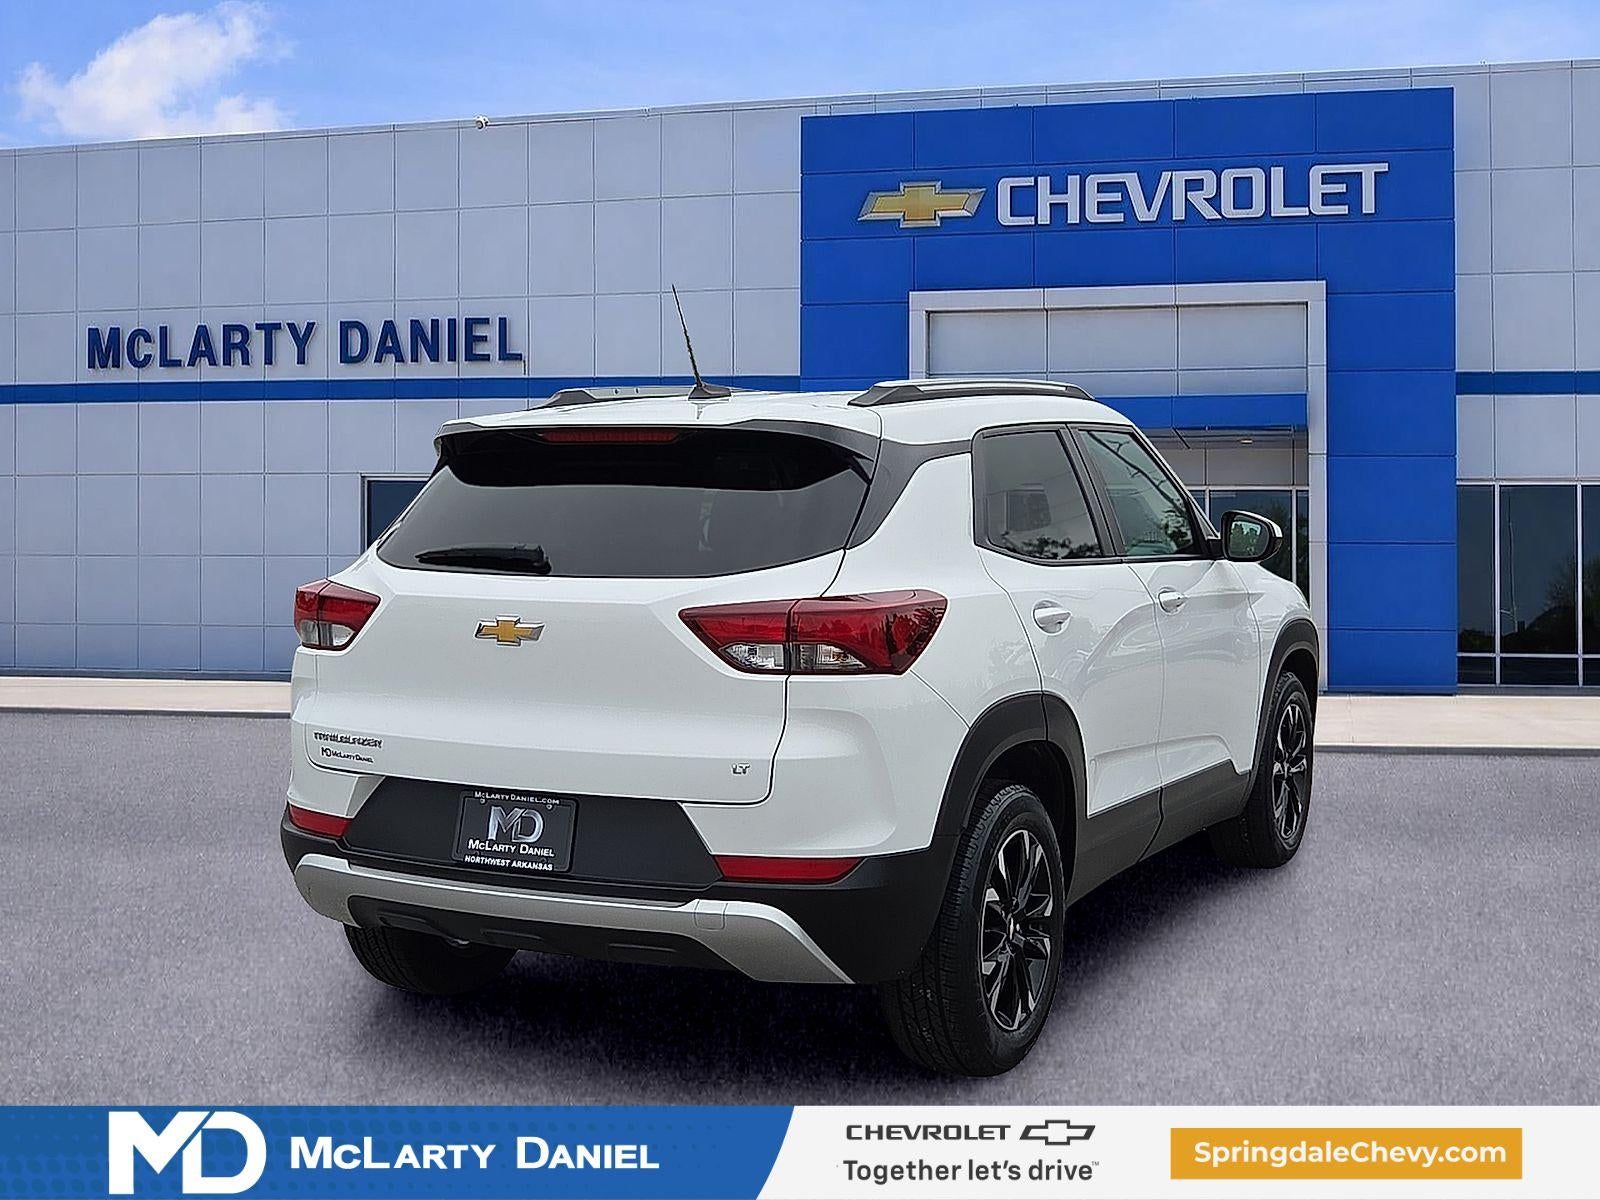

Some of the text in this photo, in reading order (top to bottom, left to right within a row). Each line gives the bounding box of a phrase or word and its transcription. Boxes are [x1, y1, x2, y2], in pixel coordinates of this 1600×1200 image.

[996, 162, 1389, 227] CHEVROLET
[339, 316, 524, 365] DANIEL
[731, 762, 751, 776] LT
[487, 805, 544, 843] MD
[464, 855, 553, 871] NORTHWEST ARKANSAS
